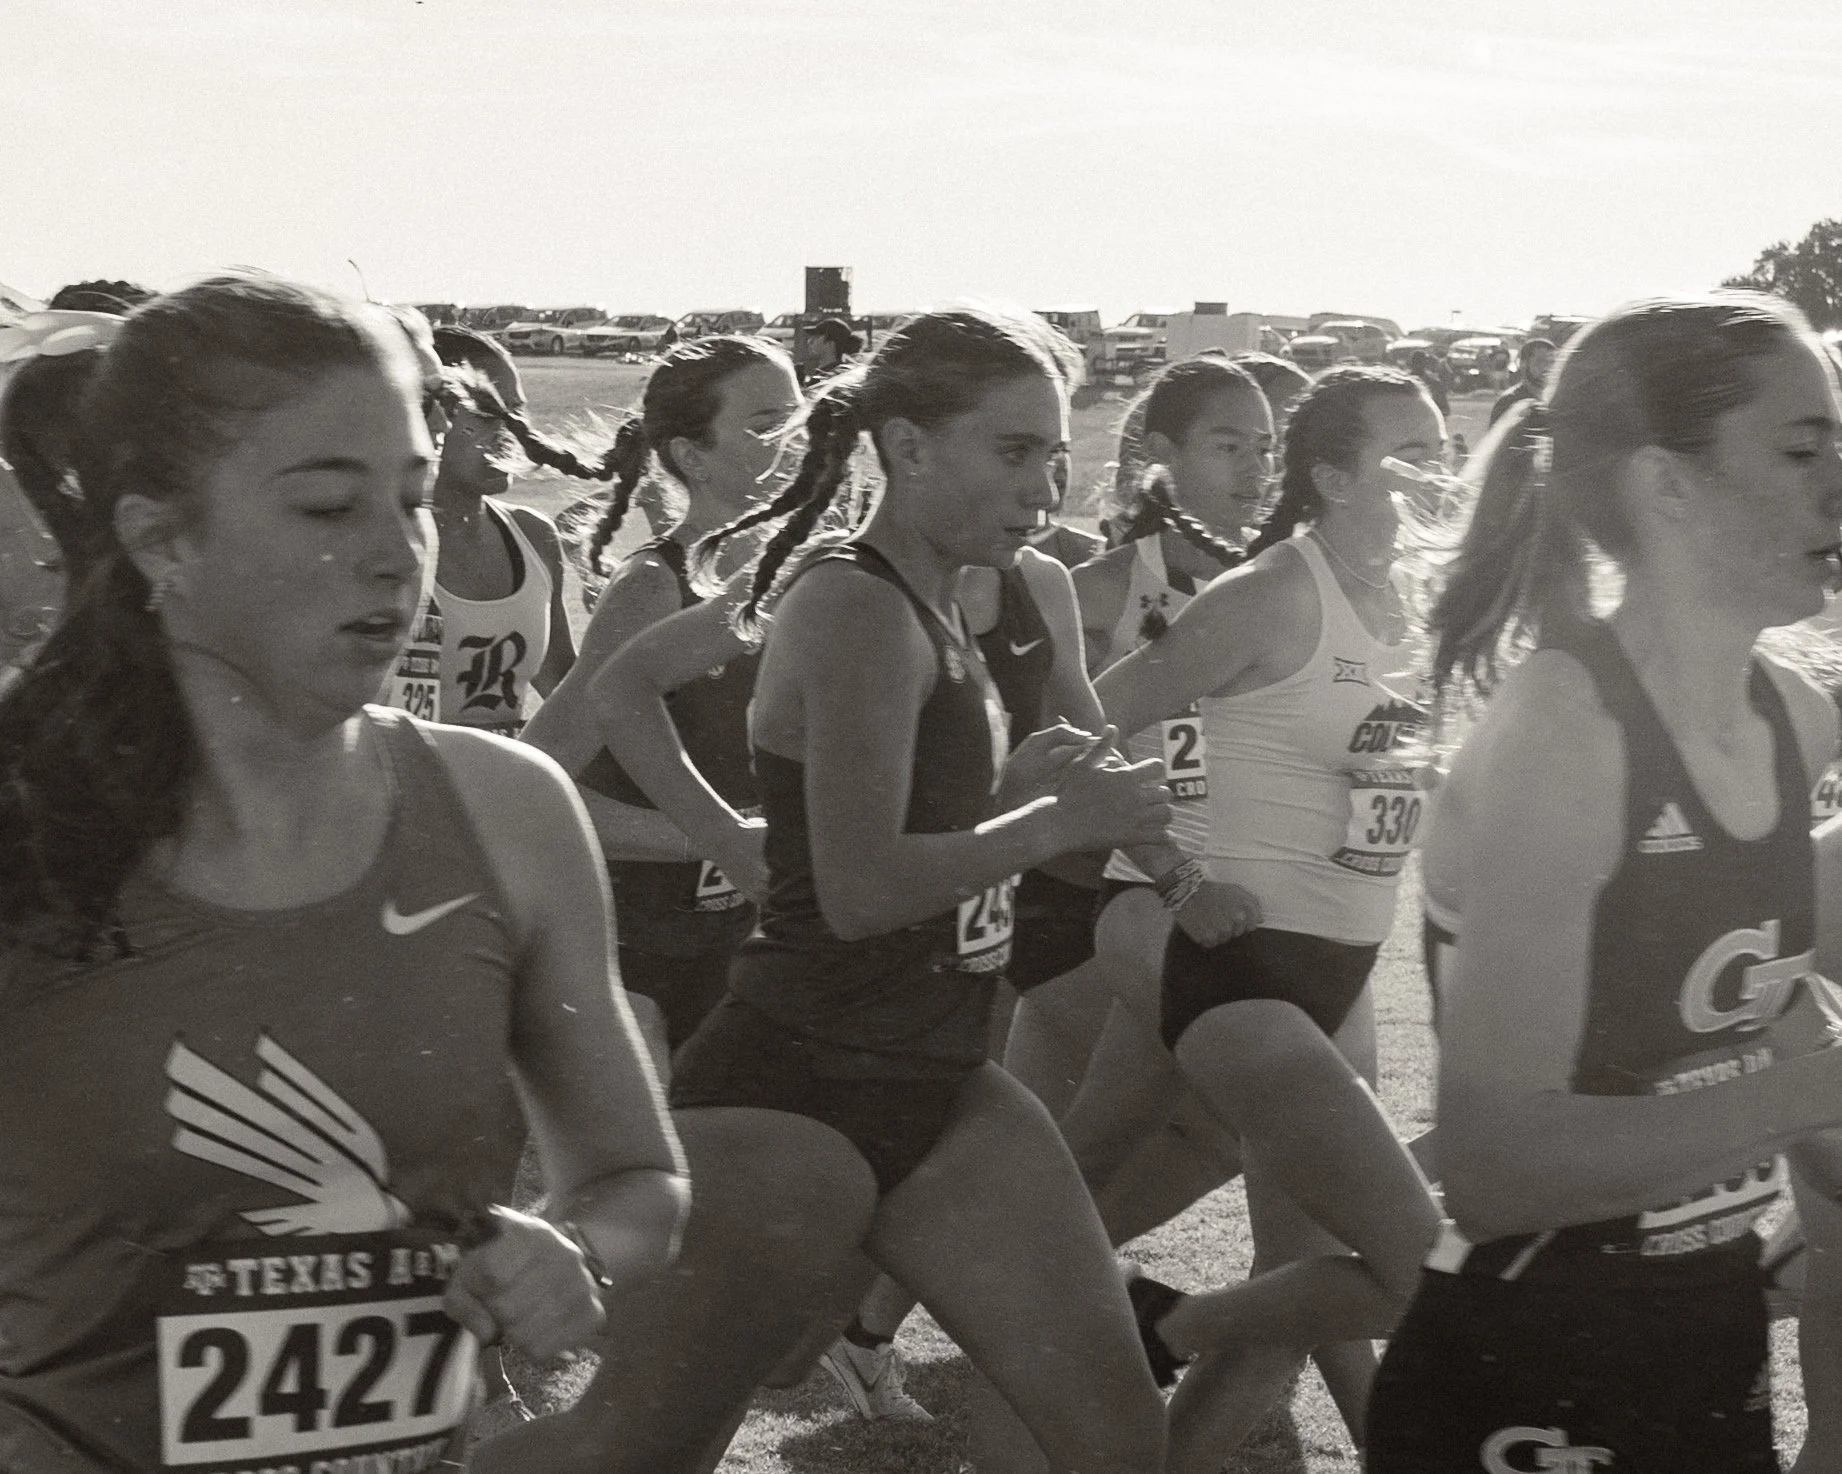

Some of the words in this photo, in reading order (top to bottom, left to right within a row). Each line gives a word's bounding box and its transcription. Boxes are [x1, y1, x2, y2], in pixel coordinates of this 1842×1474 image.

[457, 631, 527, 712] R
[1168, 723, 1201, 770] 2
[1365, 795, 1421, 845] 330
[225, 1252, 374, 1296] TEXAS
[176, 1311, 464, 1444] 2427
